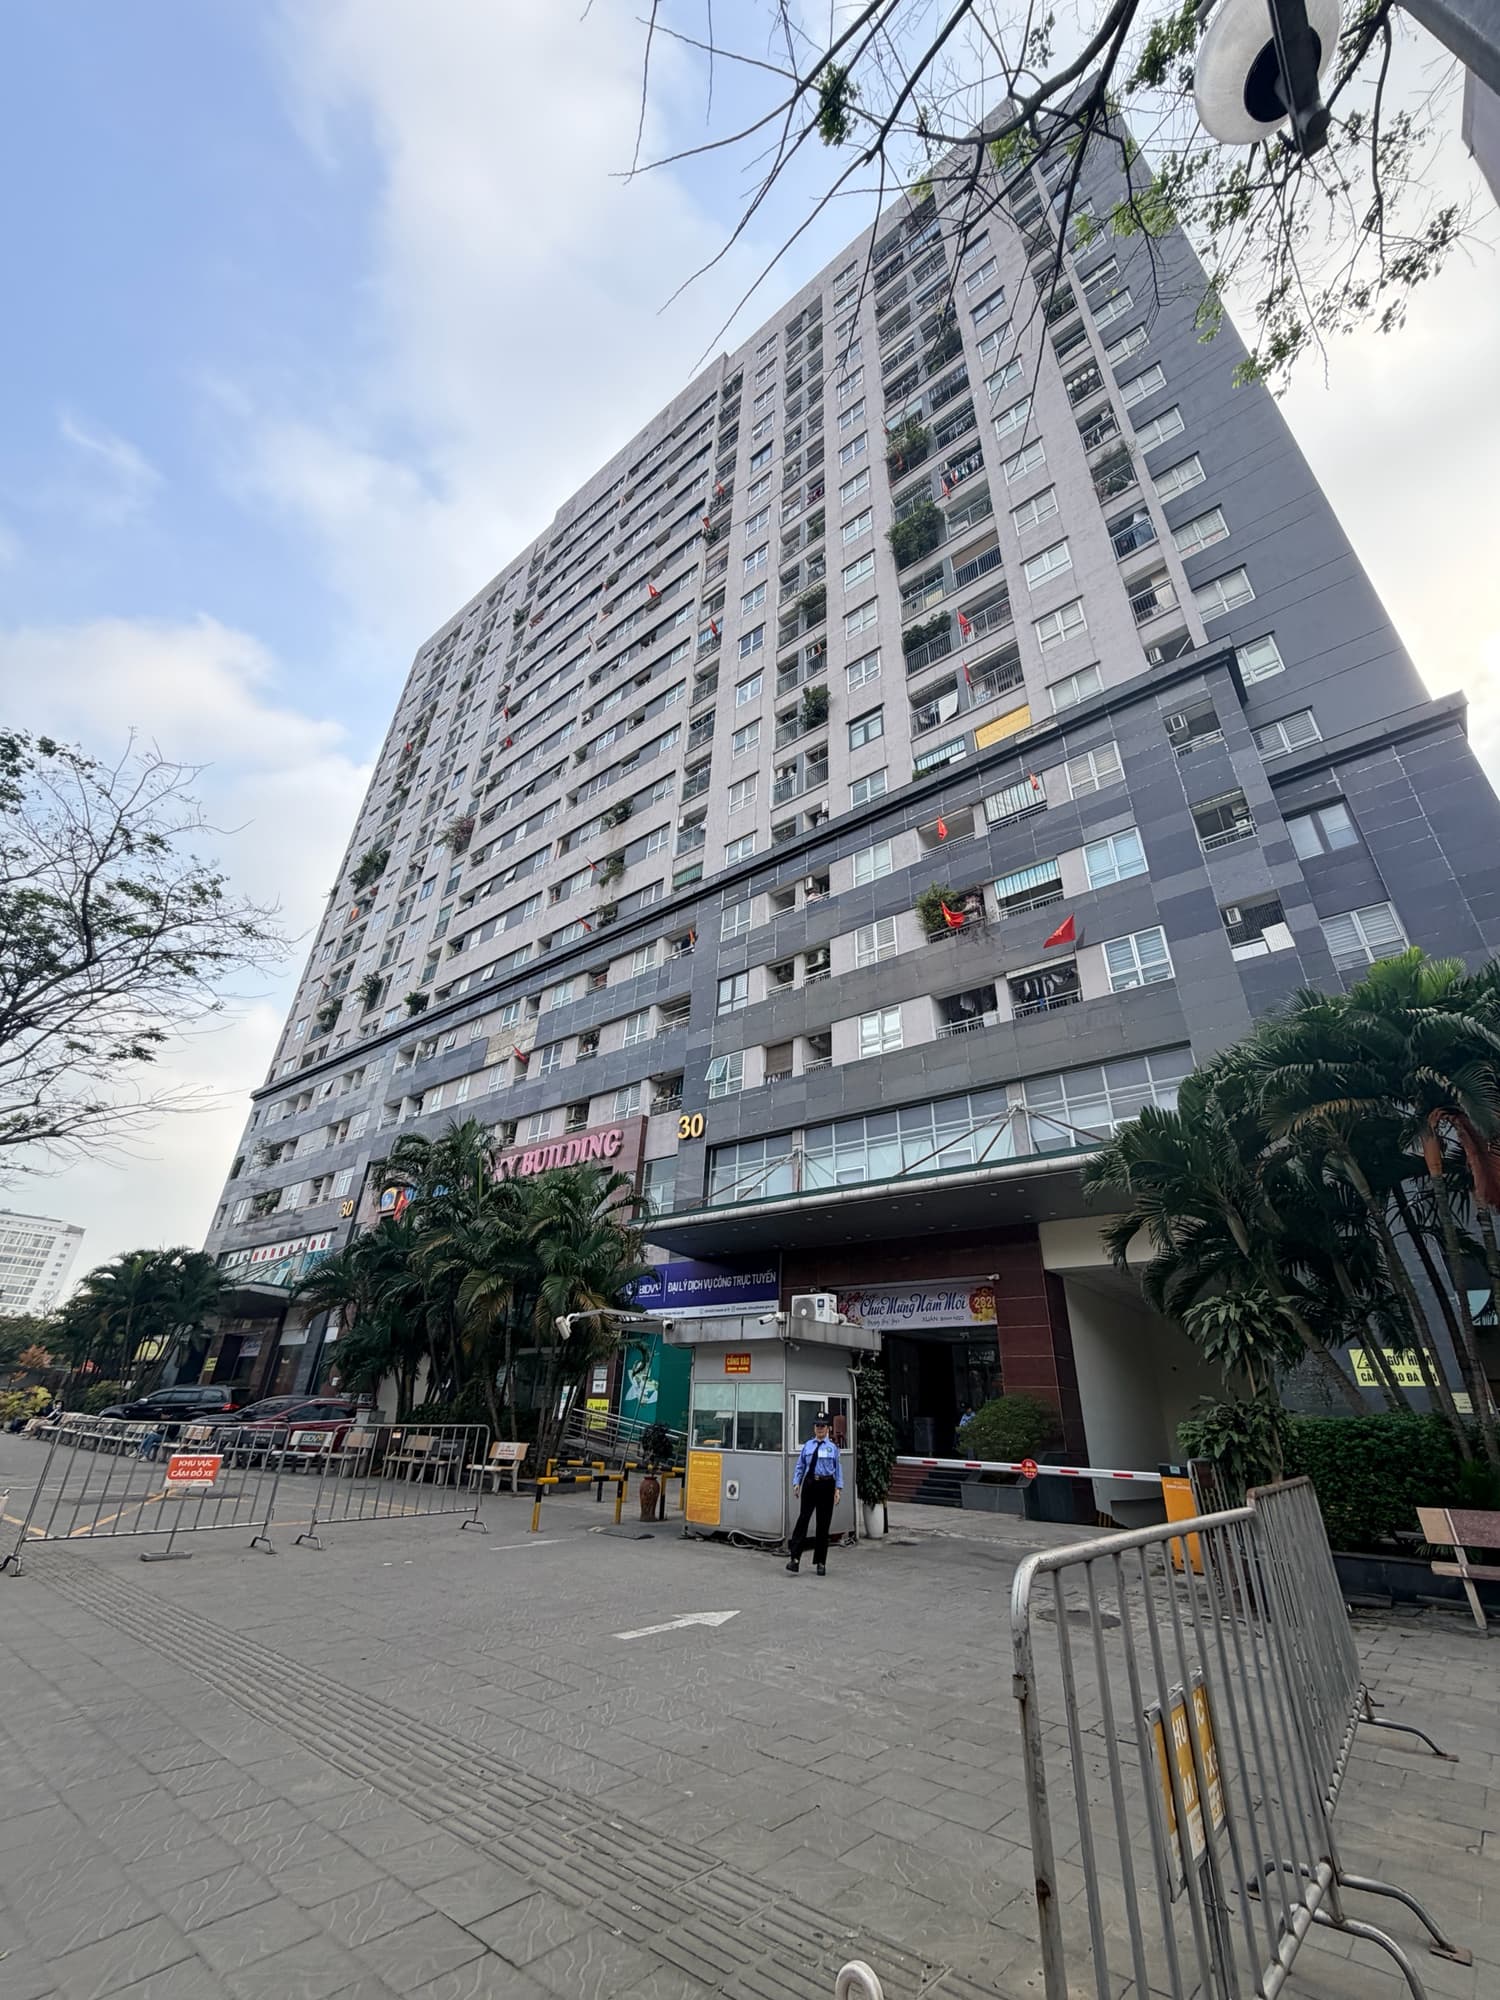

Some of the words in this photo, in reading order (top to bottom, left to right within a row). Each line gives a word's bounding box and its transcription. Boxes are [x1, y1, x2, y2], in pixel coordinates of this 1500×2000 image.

[677, 1113, 704, 1140] 30
[521, 1129, 624, 1176] BUILDING
[339, 1200, 354, 1218] 30
[668, 1281, 679, 1295] ĐẠI
[679, 1277, 688, 1293] LÝ
[688, 1280, 702, 1293] DỊCH
[704, 1279, 713, 1293] VỤ
[713, 1275, 732, 1287] CÔNG
[732, 1275, 752, 1289] TRỰC
[752, 1269, 776, 1284] TUYẾN
[860, 1294, 885, 1317] Chúc
[881, 1296, 915, 1319] Mừng
[911, 1292, 942, 1313] Năm
[938, 1291, 967, 1312] Mới
[170, 1467, 189, 1477] CẤM
[178, 1459, 196, 1467] KHU
[197, 1459, 213, 1468] VỰC
